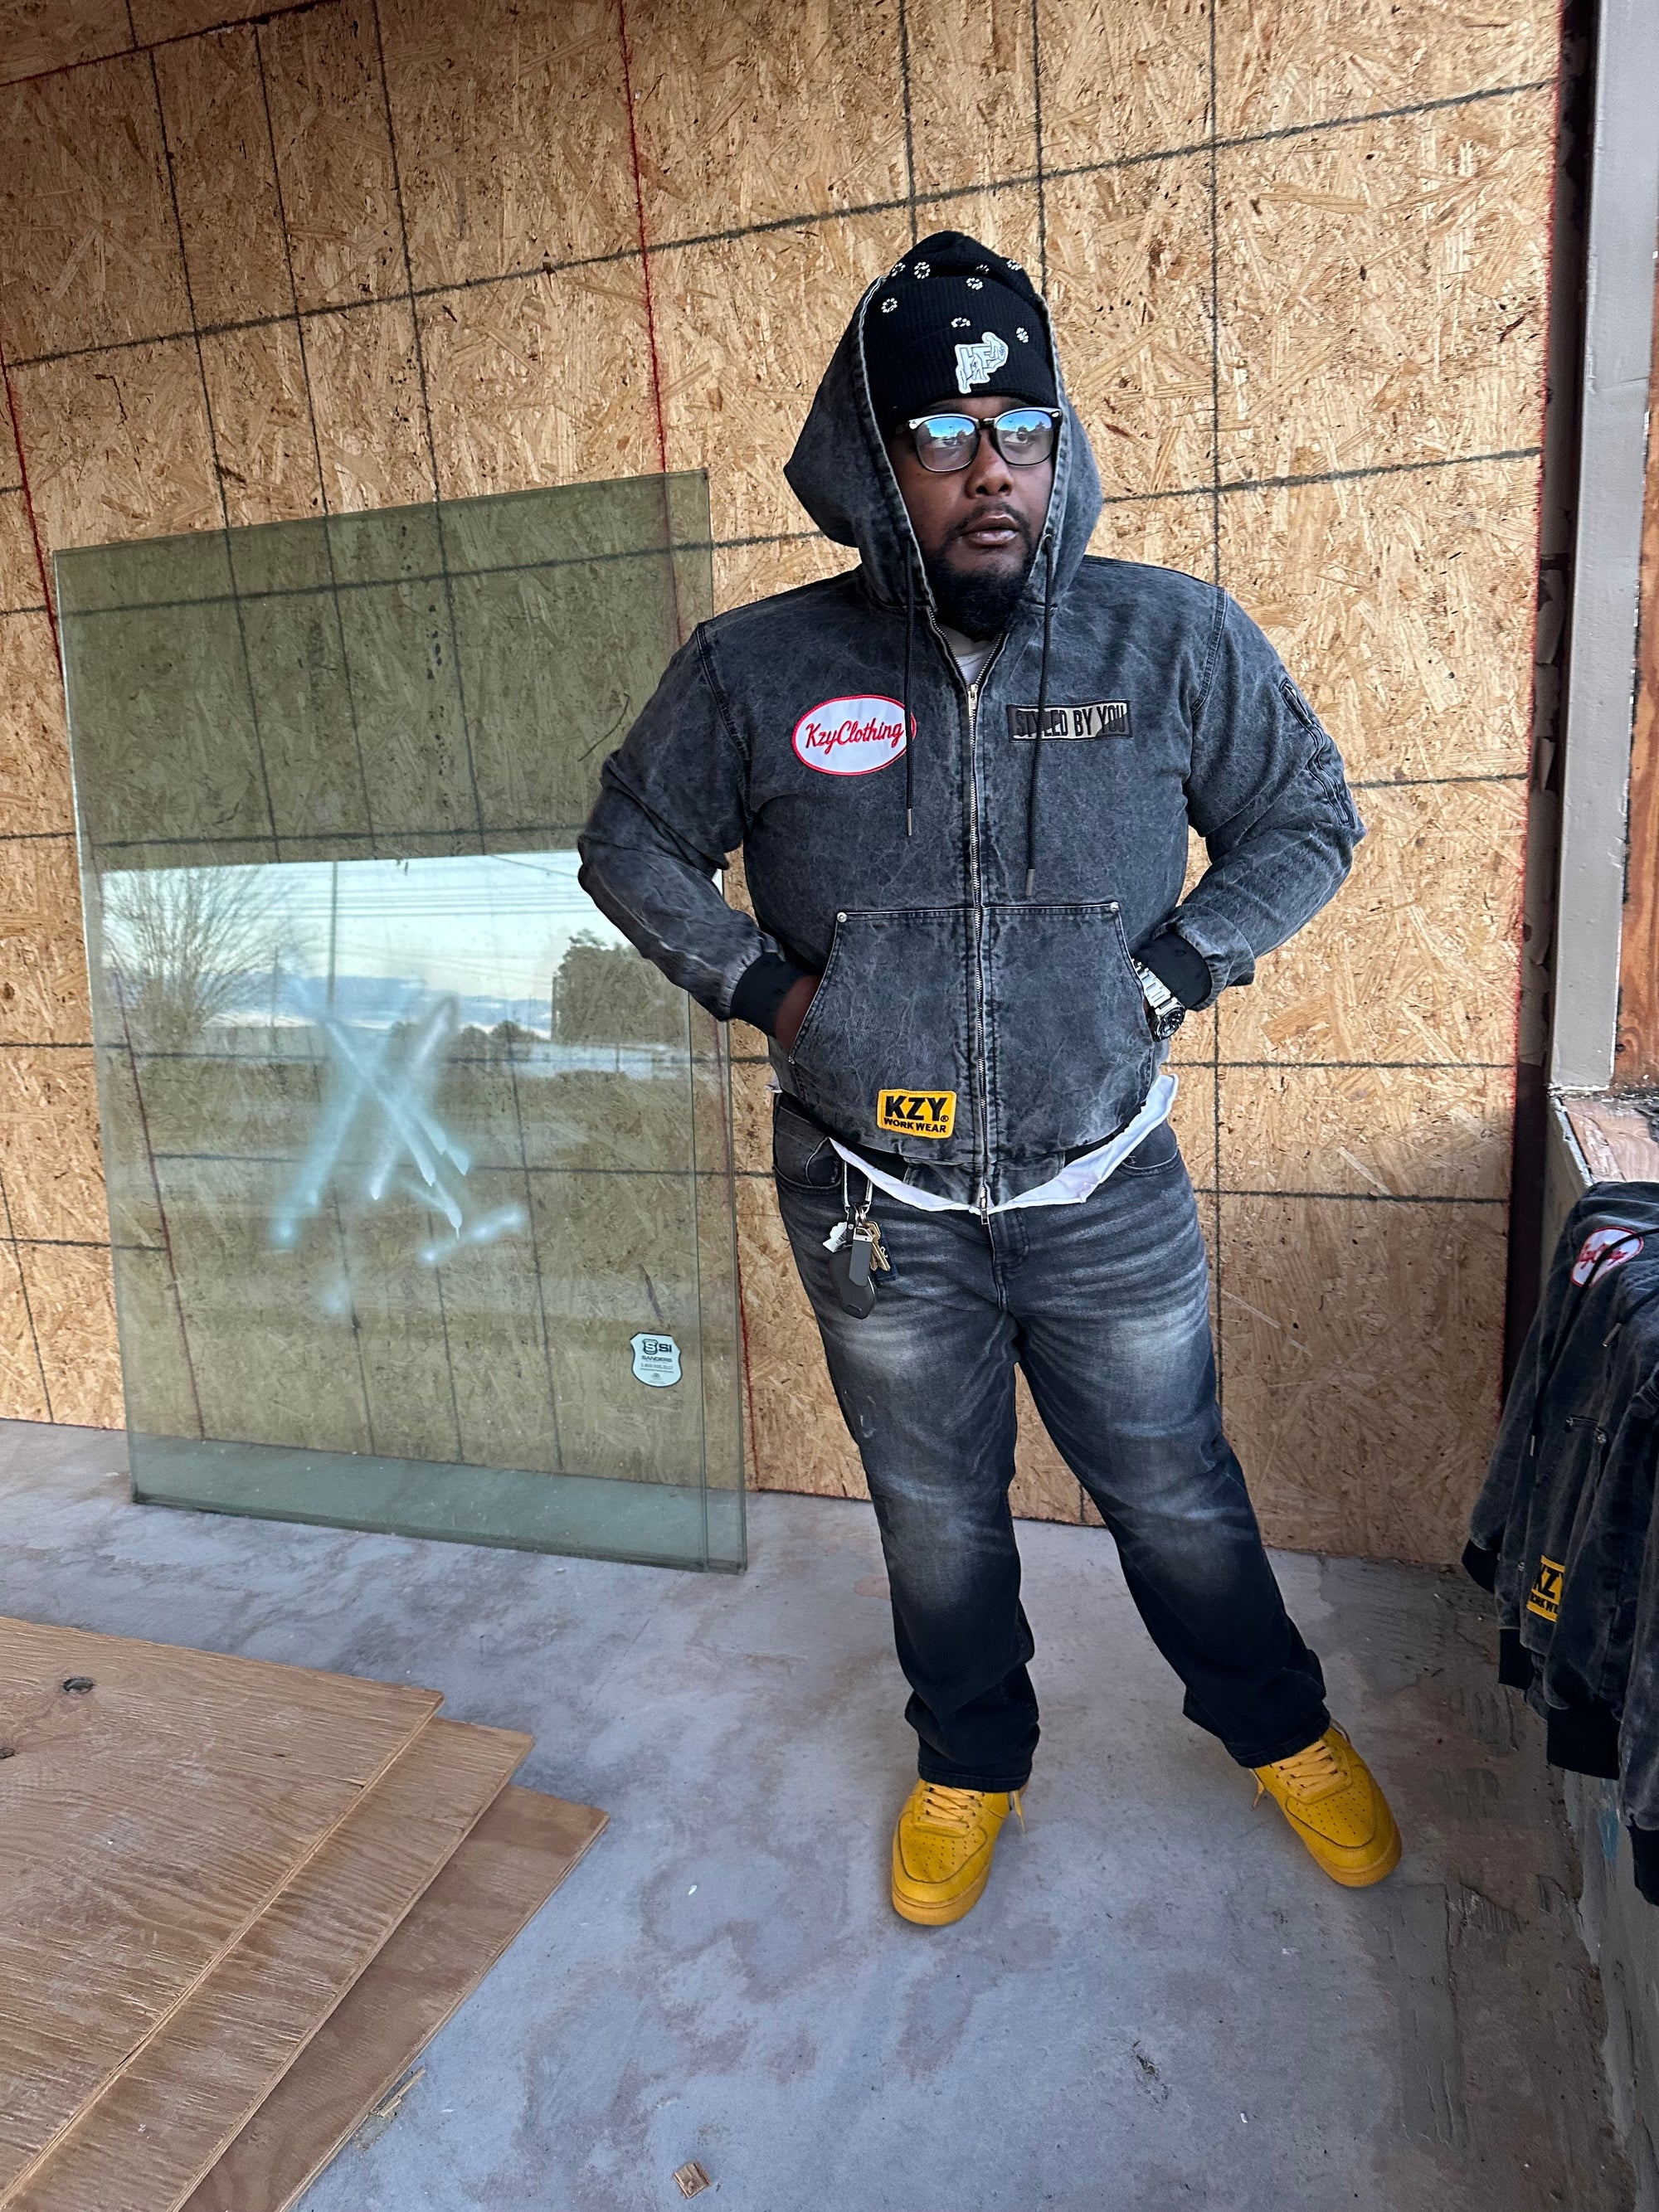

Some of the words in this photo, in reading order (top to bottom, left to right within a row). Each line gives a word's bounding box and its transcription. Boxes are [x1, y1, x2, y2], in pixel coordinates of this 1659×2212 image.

[805, 717, 904, 755] KzyClothing
[1073, 707, 1092, 737] BY
[1096, 704, 1126, 734] YOU
[885, 1095, 947, 1122] KZY
